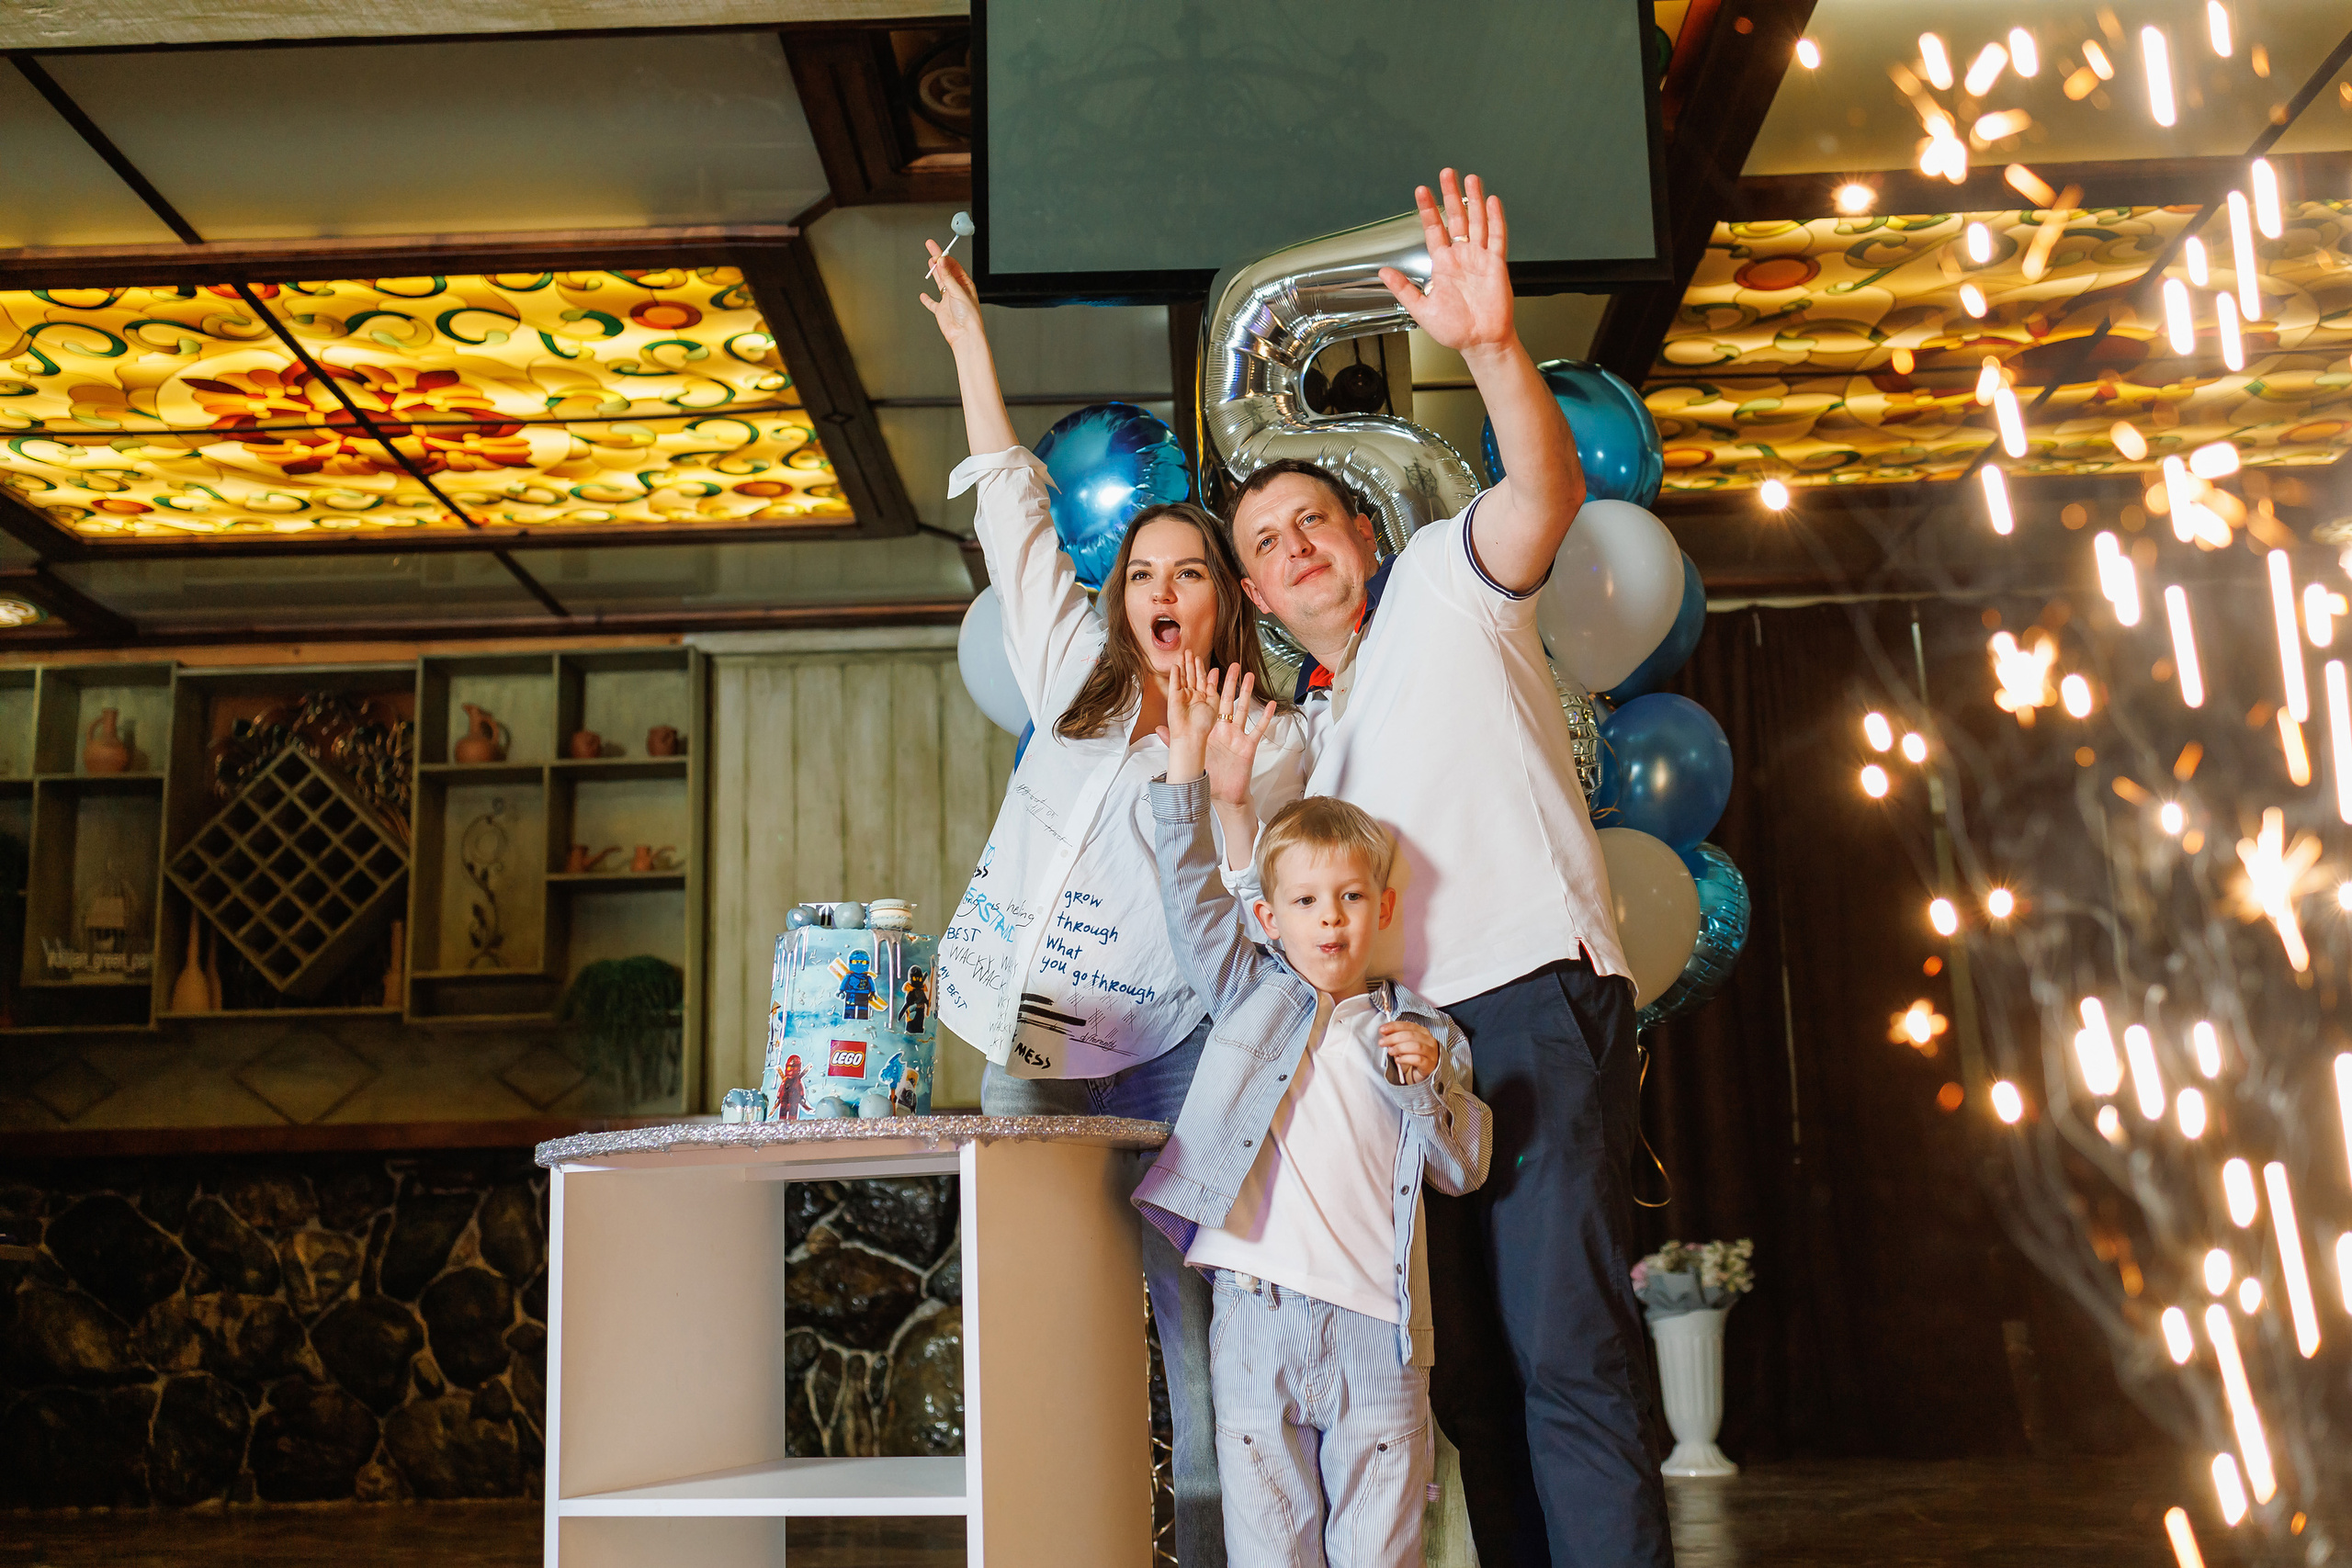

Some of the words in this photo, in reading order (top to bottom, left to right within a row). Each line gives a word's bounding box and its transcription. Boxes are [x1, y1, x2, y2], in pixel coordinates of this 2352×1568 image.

[946, 926, 981, 942] BEST
[1040, 955, 1068, 975] you
[1072, 970, 1088, 987] go
[946, 983, 967, 1010] BEST
[831, 1051, 864, 1066] LEGO
[1014, 1042, 1052, 1069] MESS
